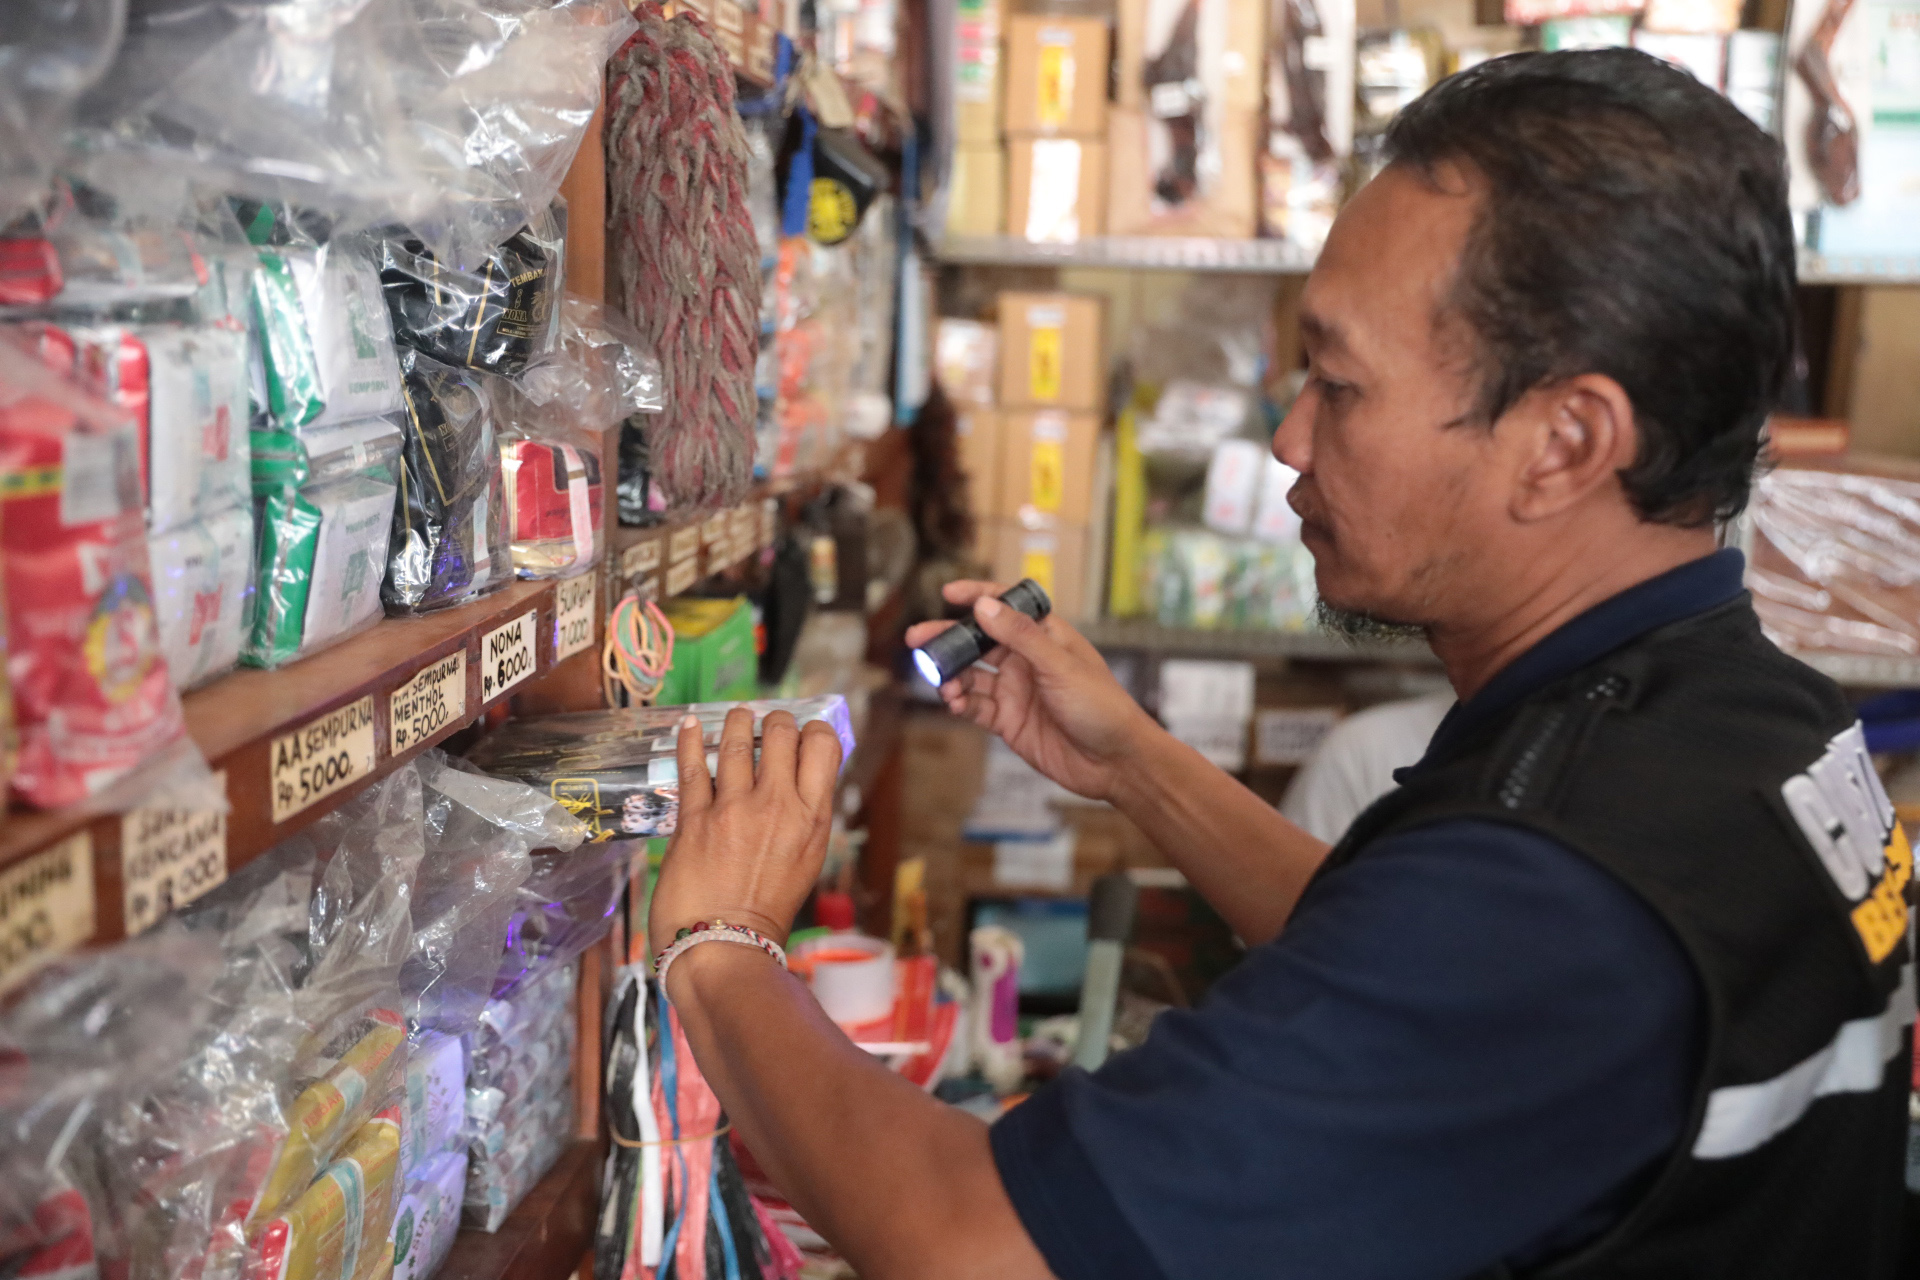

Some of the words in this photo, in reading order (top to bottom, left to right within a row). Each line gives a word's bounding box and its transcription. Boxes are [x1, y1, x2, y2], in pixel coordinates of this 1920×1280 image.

[490, 621, 522, 663] NONA
[394, 684, 445, 726] MENTHOL
[275, 732, 302, 778] AA
[305, 700, 373, 760] SEMPURNA
